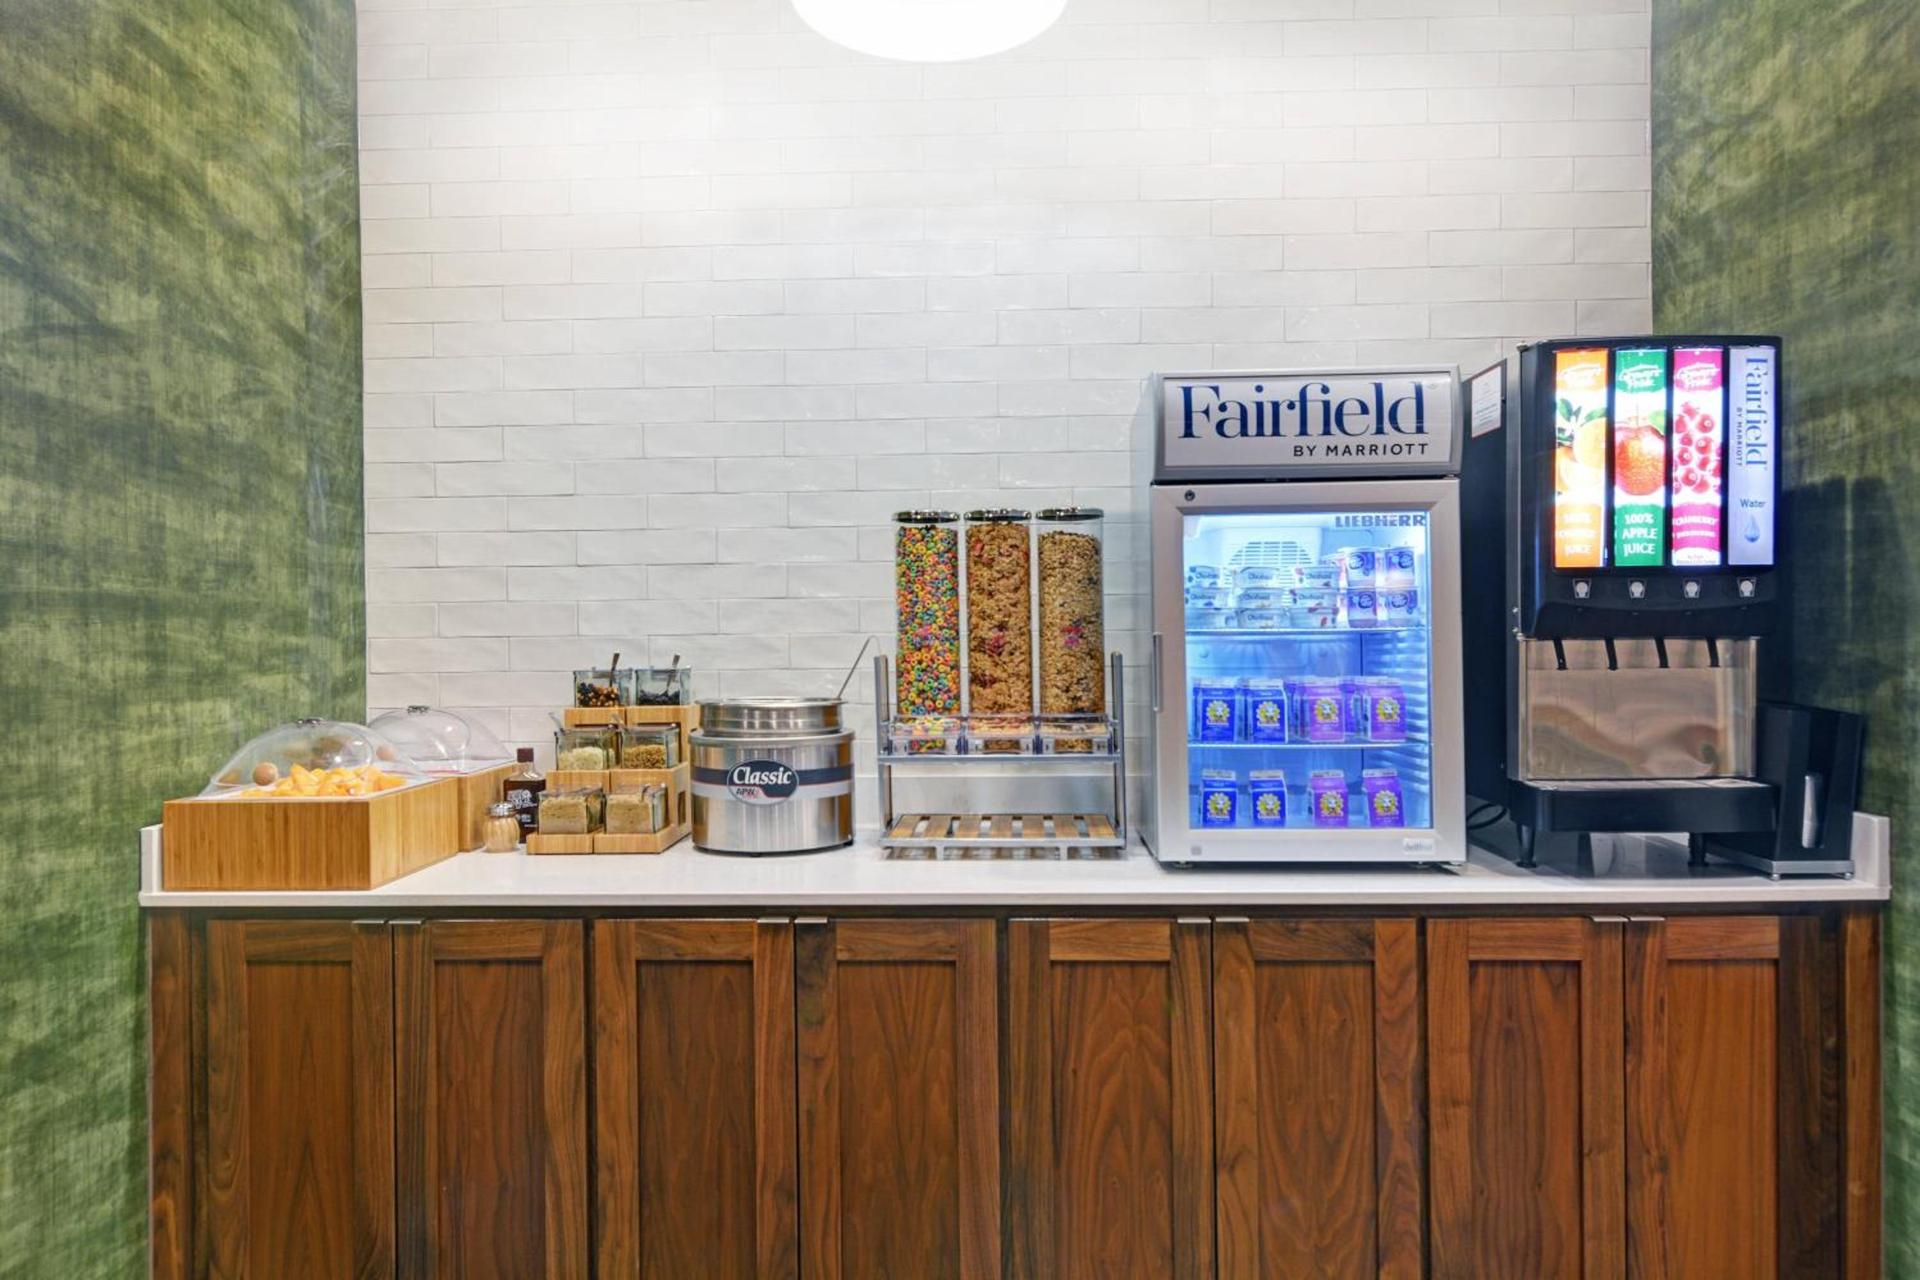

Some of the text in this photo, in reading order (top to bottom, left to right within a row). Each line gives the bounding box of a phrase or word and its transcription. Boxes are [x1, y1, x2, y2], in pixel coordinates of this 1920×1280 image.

[1177, 381, 1429, 438] Fairfield
[1745, 358, 1769, 465] Fairfield
[1293, 443, 1429, 457] BY MARRIOTT
[1740, 498, 1766, 508] Water
[1335, 515, 1426, 527] LIEBHERR
[1624, 513, 1654, 525] 100%
[1622, 528, 1658, 539] APPLE
[1623, 543, 1655, 556] JUICE
[733, 766, 793, 785] Classic
